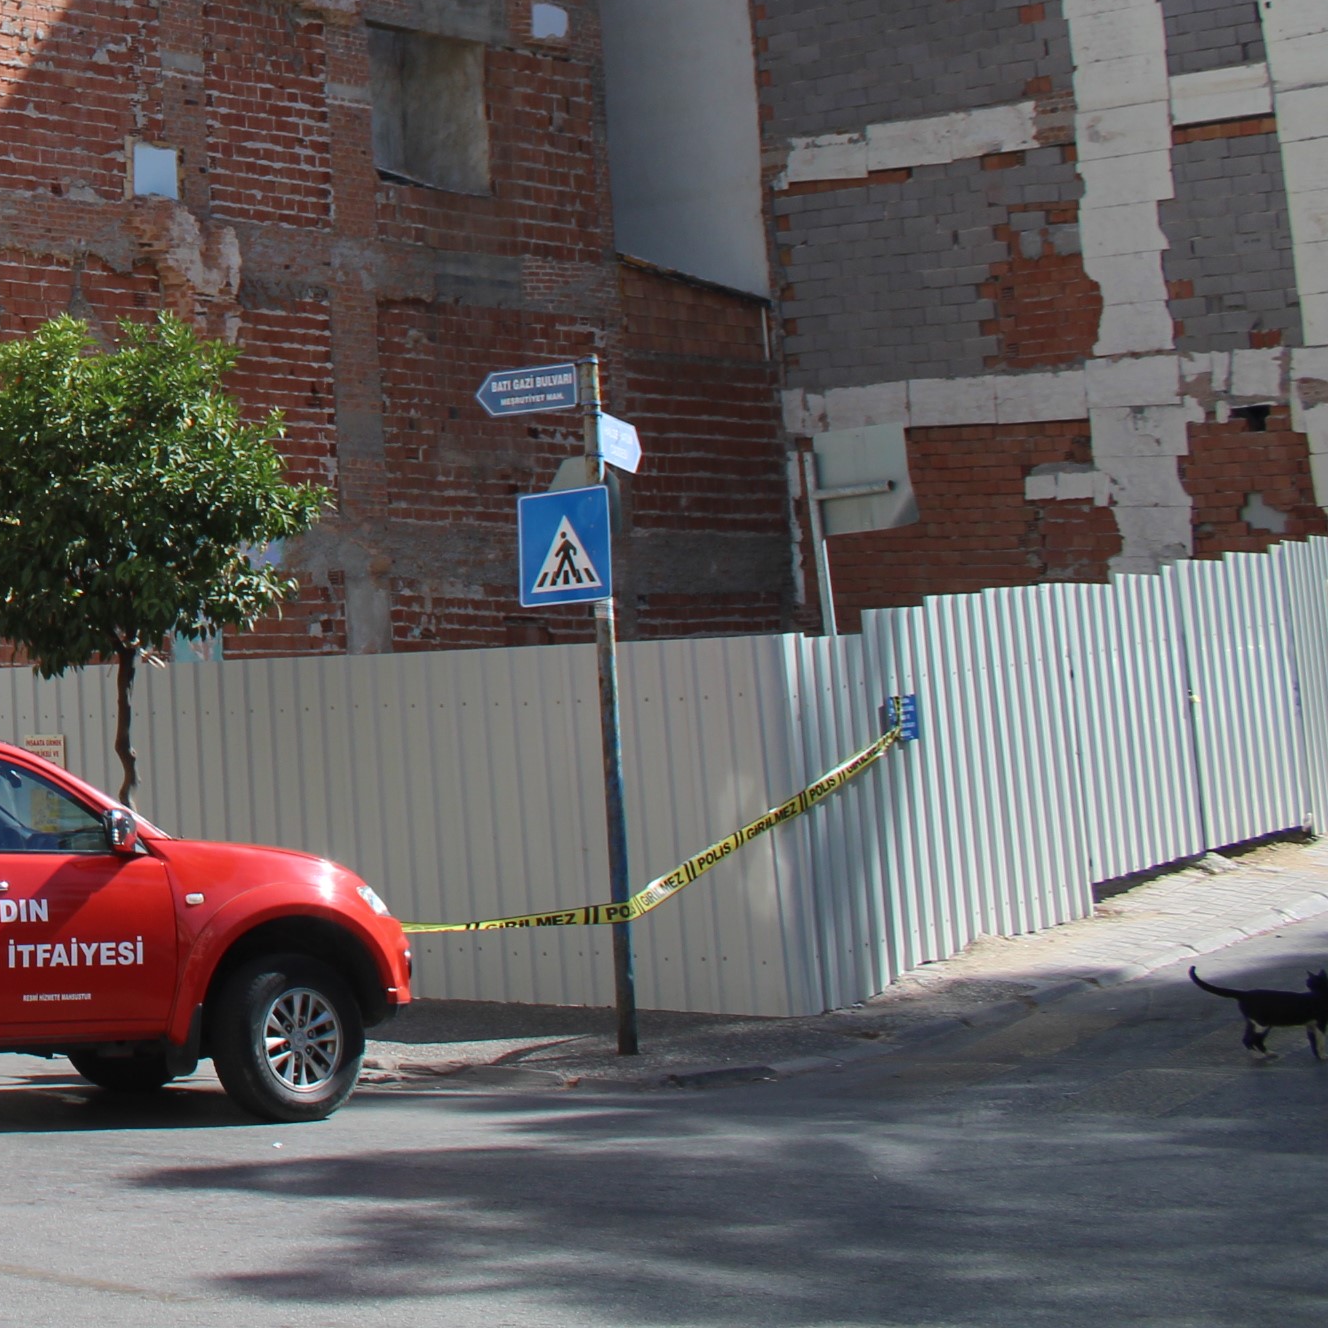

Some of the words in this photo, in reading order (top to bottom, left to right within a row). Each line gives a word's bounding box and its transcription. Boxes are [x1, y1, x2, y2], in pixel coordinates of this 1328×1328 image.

[491, 379, 512, 393] BATI
[513, 375, 535, 391] GAZİ
[536, 372, 573, 388] BULVARI
[745, 801, 799, 841] GİRİLMEZ
[696, 841, 732, 871] POLİS
[8, 935, 145, 969] İTFAİYESİ
